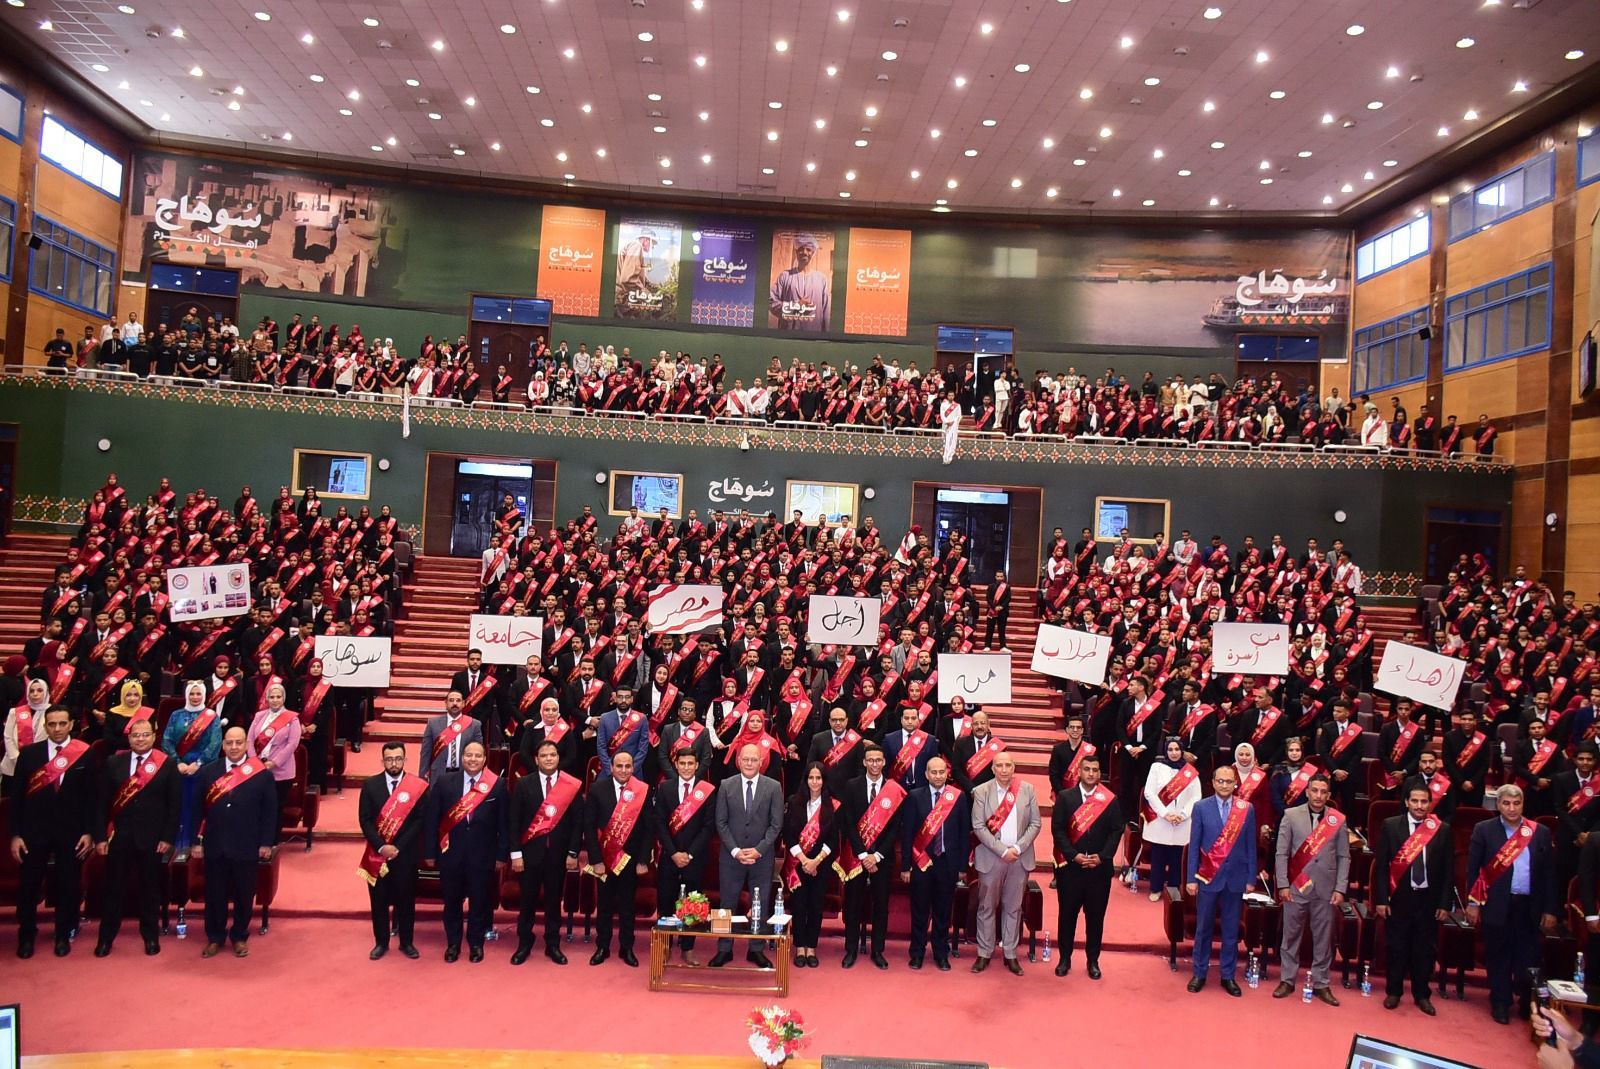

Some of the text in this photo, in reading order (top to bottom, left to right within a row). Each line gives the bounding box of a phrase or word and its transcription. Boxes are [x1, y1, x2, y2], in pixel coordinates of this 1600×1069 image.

[153, 230, 209, 244] الكرم
[1236, 304, 1287, 317] الكرم
[651, 596, 709, 627] مصر
[822, 599, 865, 639] أجل
[476, 619, 542, 648] جامعة
[320, 638, 382, 679] سوهاج
[1041, 635, 1098, 663] طلاب
[1224, 645, 1260, 667] أسرة
[1389, 655, 1456, 703] إهداء
